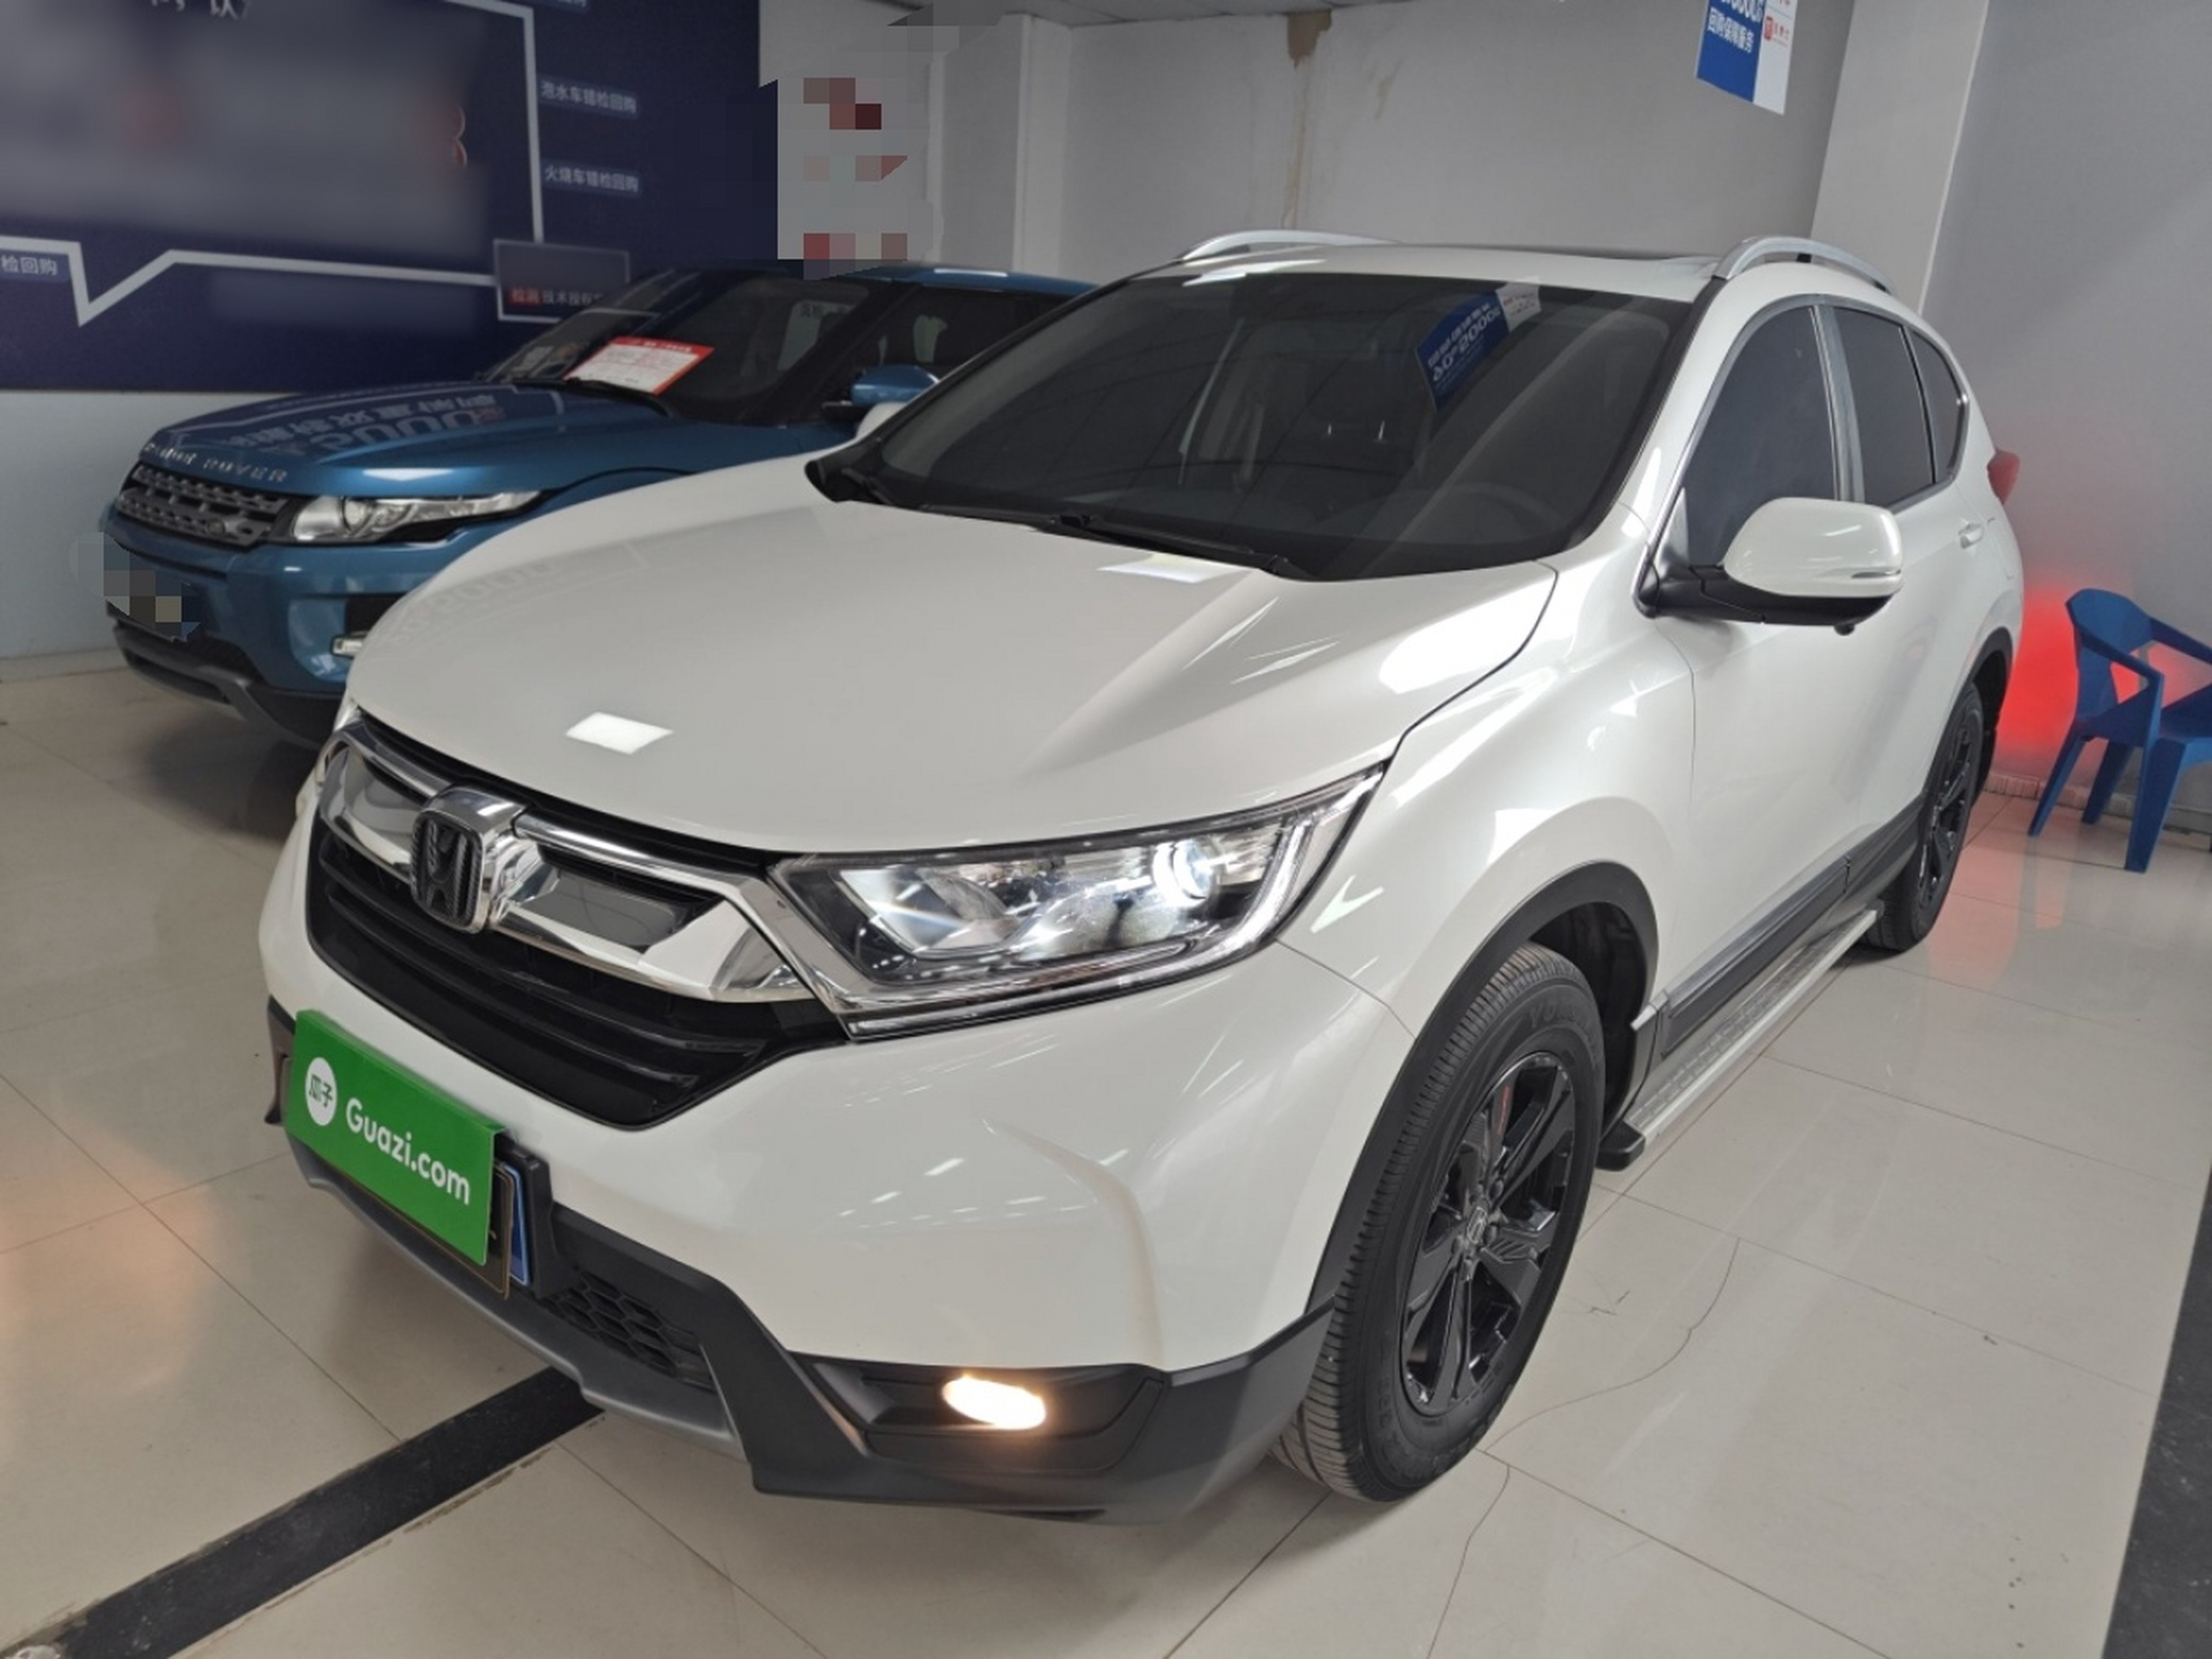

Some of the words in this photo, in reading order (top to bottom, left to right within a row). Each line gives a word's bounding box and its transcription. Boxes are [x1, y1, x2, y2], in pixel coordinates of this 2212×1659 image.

[1, 255, 58, 275] 检回购
[308, 1074, 333, 1108] 瓜子
[346, 1097, 470, 1206] Guazi.com
